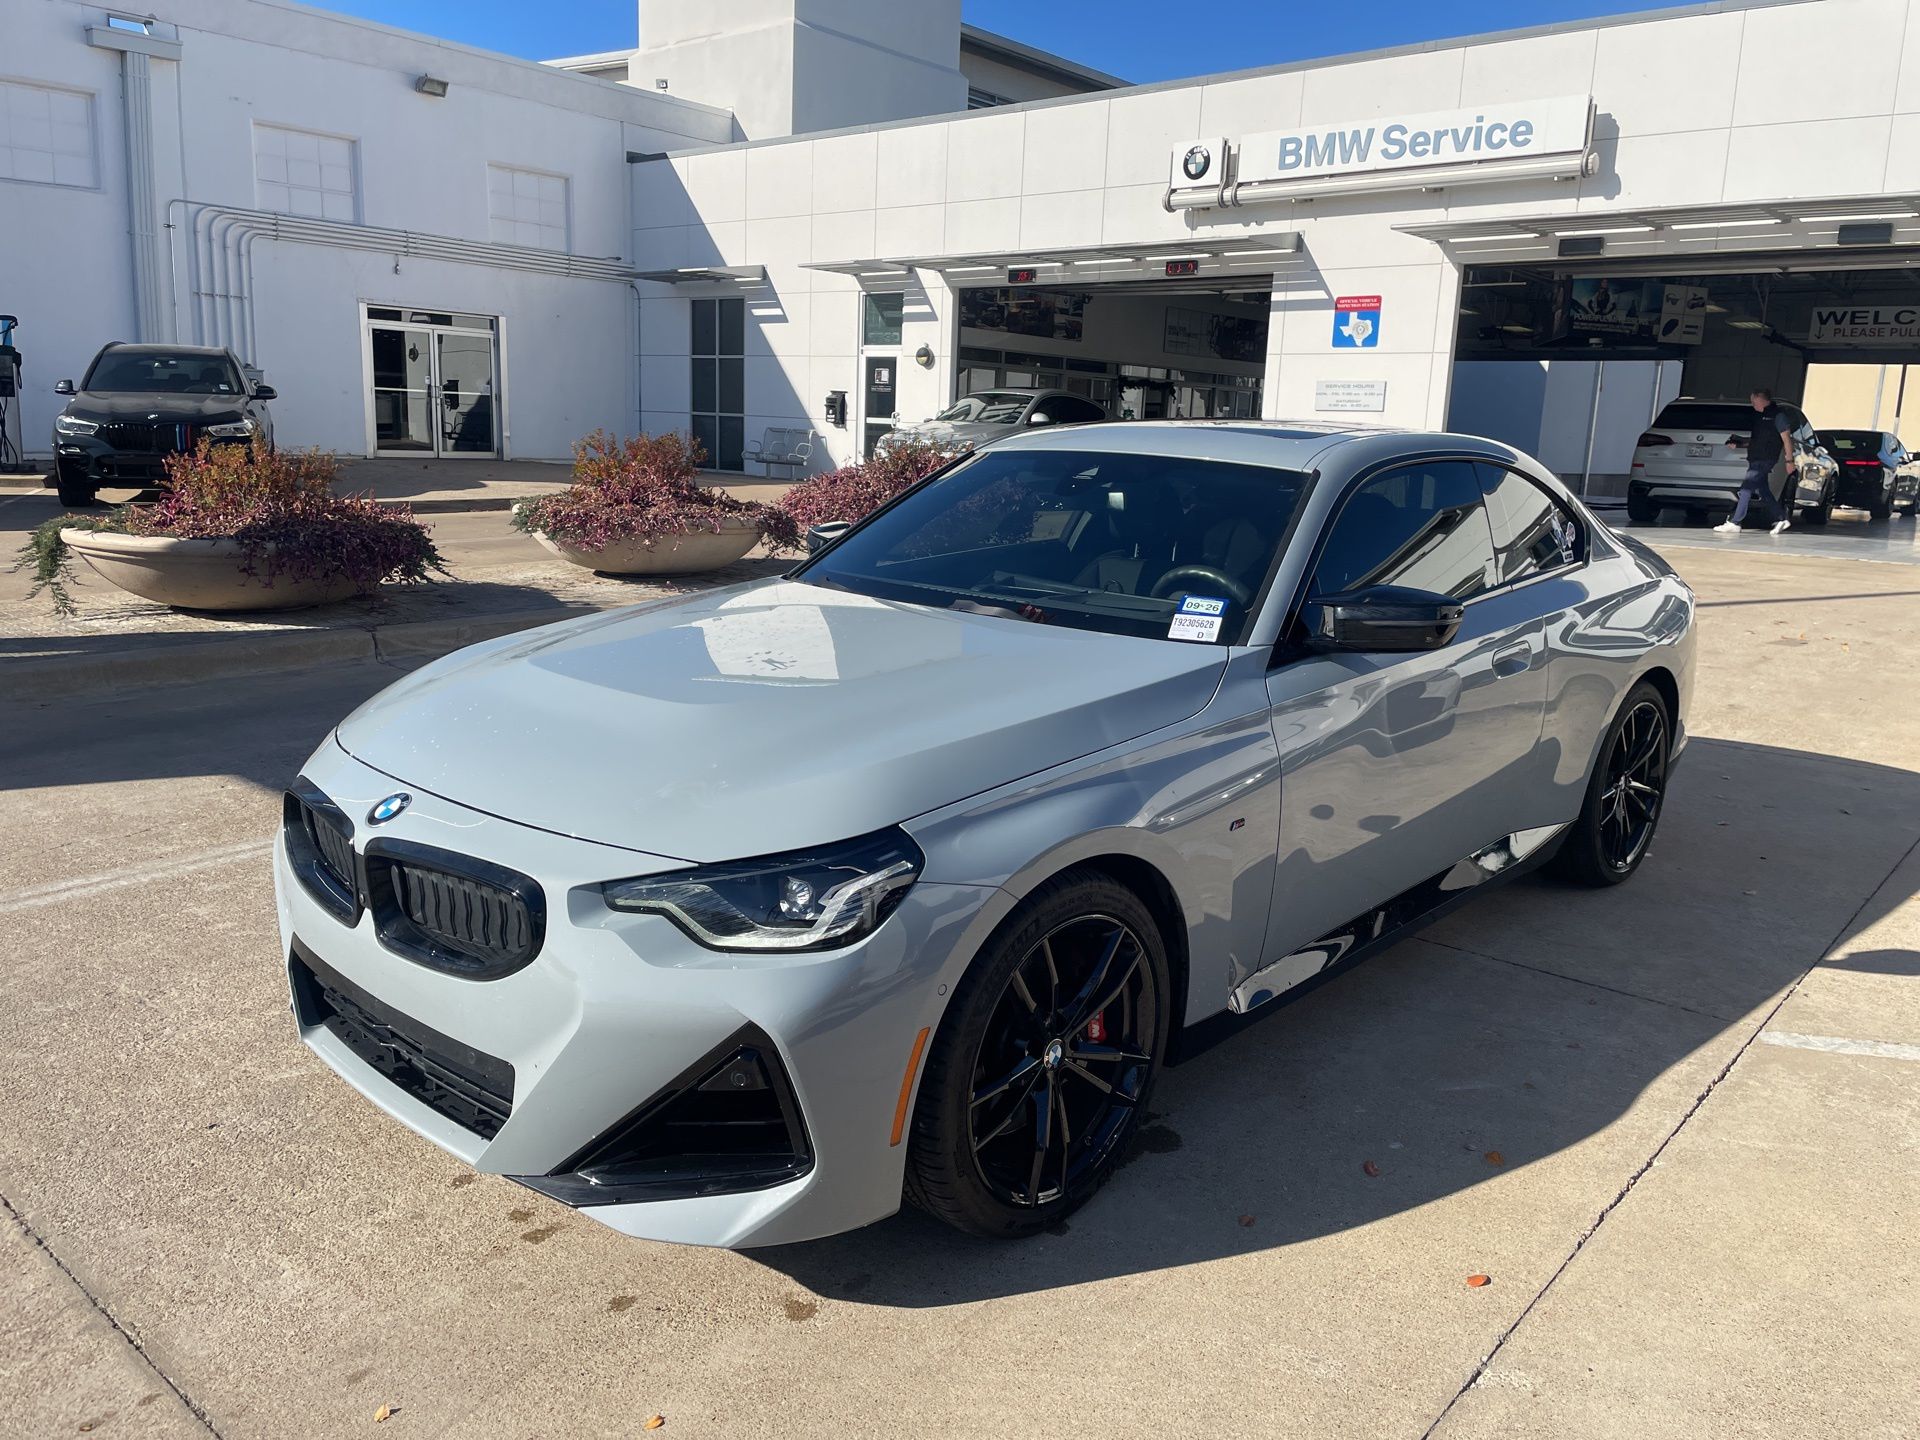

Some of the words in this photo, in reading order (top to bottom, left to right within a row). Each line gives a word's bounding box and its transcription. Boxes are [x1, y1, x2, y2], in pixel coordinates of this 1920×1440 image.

[1278, 127, 1375, 170] BMW
[1380, 115, 1534, 160] Service
[1816, 309, 1920, 325] WELC
[1833, 327, 1886, 337] PLEASE
[1197, 631, 1204, 639] D
